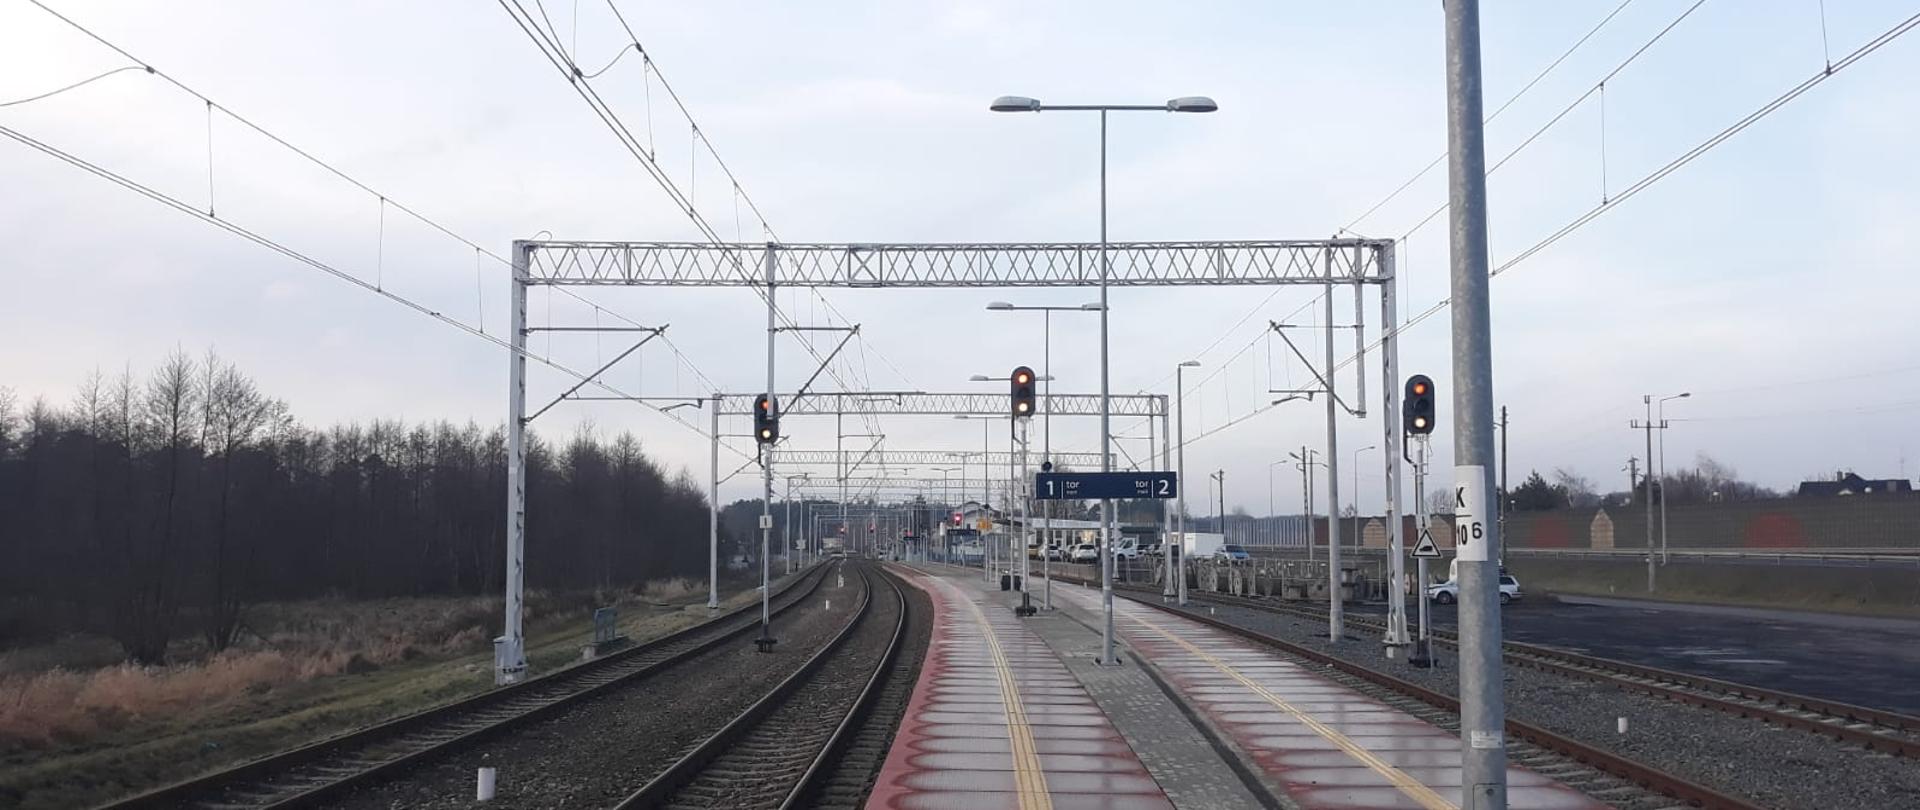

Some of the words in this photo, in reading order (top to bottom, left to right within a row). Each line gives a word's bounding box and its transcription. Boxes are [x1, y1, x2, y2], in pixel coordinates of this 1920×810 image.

[1046, 480, 1054, 495] 1
[1066, 481, 1080, 489] tor
[1135, 480, 1149, 488] tor
[1158, 480, 1169, 495] 2
[1472, 522, 1483, 539] 6
